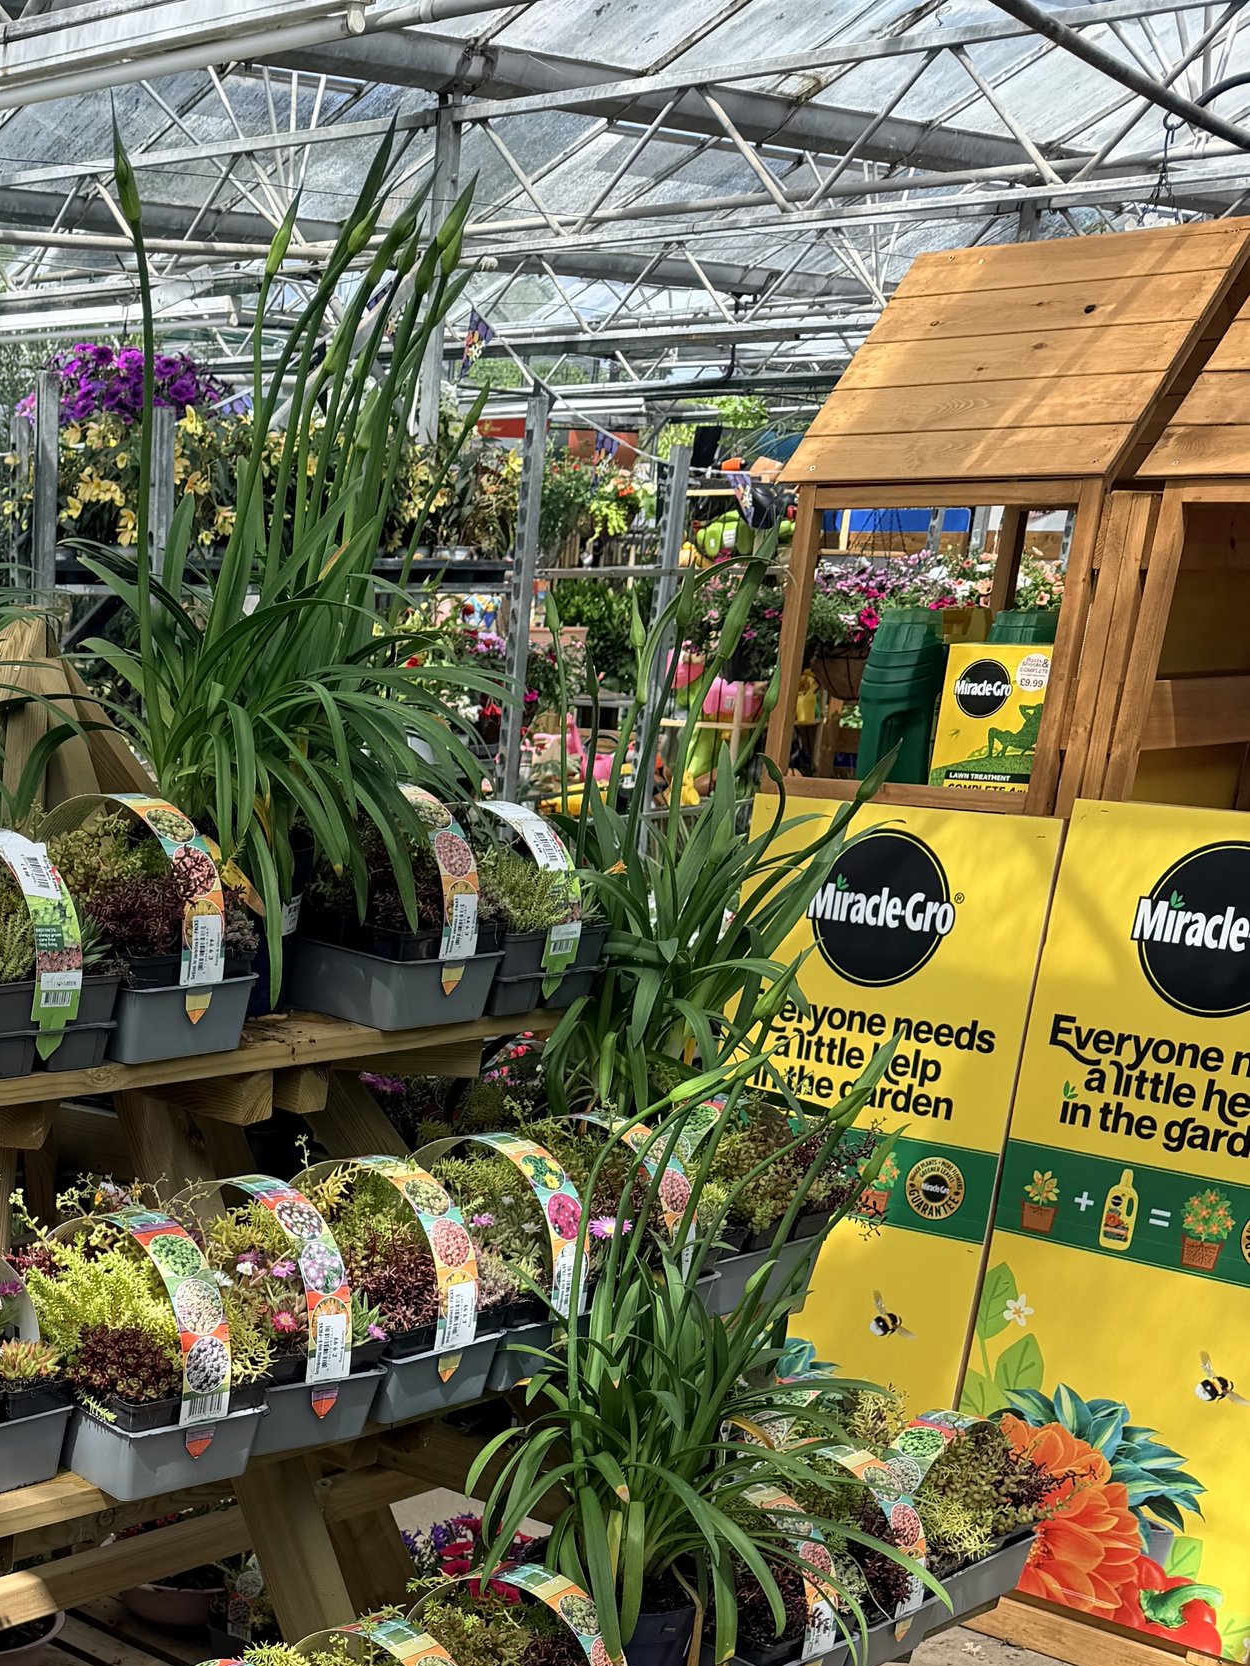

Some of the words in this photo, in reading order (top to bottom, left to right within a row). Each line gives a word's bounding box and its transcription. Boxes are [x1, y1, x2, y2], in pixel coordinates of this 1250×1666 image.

[1020, 678, 1043, 688] £9.99
[970, 773, 1011, 782] TREATMENT
[808, 883, 954, 935] Miracle-Gro
[757, 987, 886, 1036] eryone
[893, 1016, 997, 1054] needs
[775, 1034, 790, 1057] a
[791, 1028, 865, 1068] little
[1049, 1013, 1224, 1073] Everyone
[1084, 1067, 1106, 1094] a
[1109, 1060, 1196, 1108] little
[1059, 1100, 1092, 1128] in
[1099, 1101, 1158, 1140] the
[909, 1190, 959, 1217] GUARANTEE
